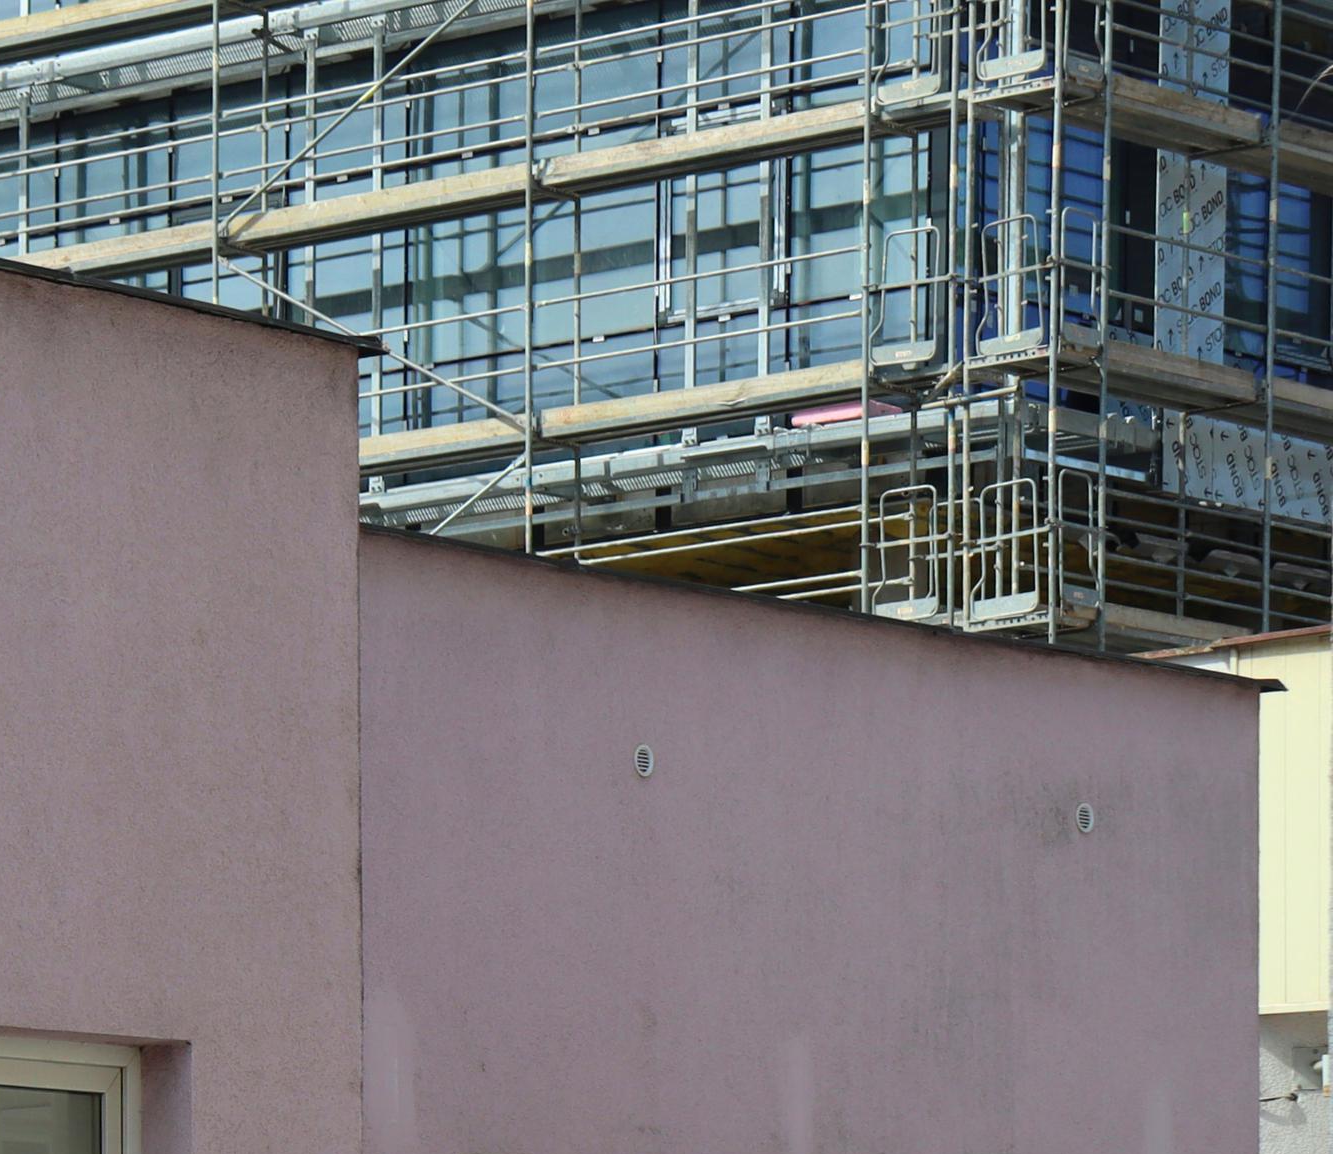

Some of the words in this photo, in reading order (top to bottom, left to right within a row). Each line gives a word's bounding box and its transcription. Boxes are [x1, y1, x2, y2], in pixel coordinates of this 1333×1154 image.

[1173, 174, 1196, 204] BOD
[1201, 190, 1223, 220] BOND
[1171, 266, 1194, 296] BOD
[1199, 281, 1222, 311] BOND
[1226, 453, 1244, 499] BOND
[1270, 463, 1286, 508] BOND
